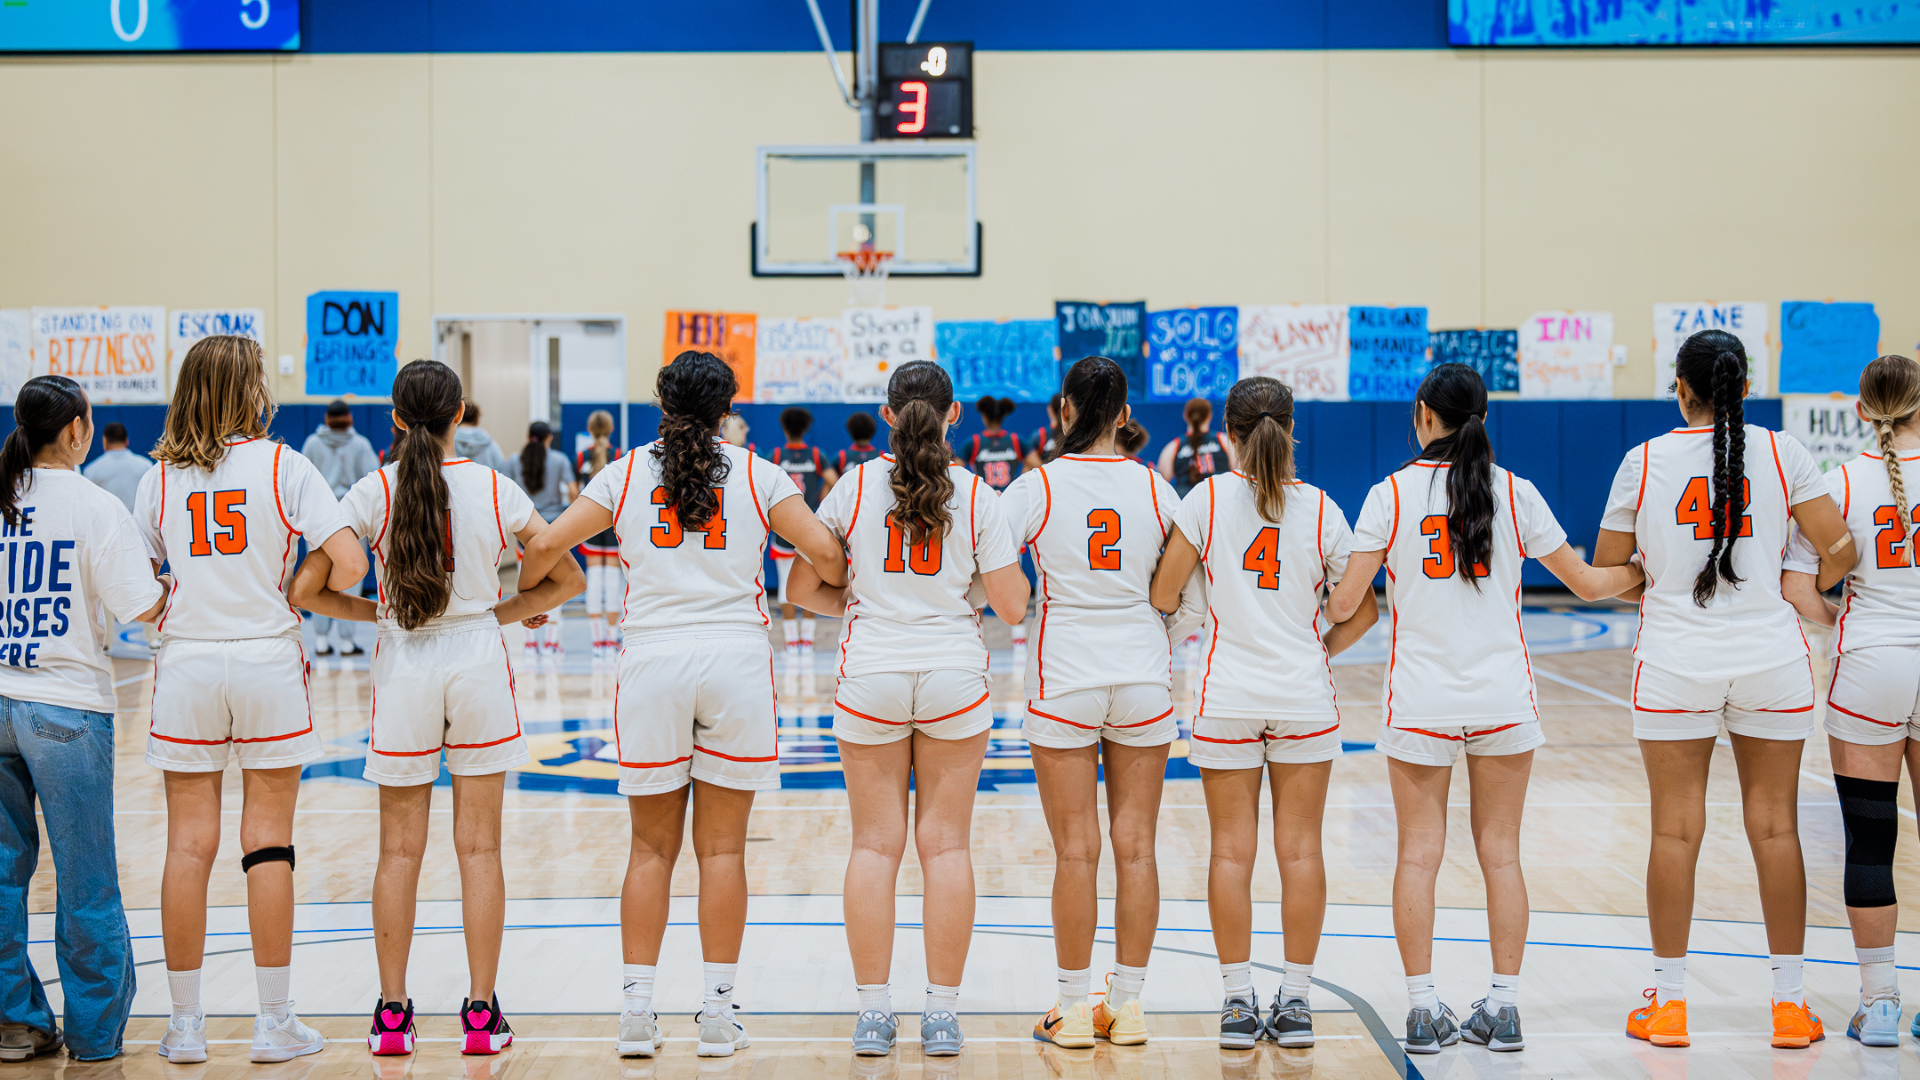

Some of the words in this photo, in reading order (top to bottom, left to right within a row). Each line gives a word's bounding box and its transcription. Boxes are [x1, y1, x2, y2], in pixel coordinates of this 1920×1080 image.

[896, 81, 928, 132] 3
[40, 313, 122, 334] STANDING
[129, 313, 153, 331] ON
[179, 311, 257, 338] ESCOBAR
[323, 301, 384, 335] DON
[851, 311, 920, 337] Shoot
[1151, 311, 1238, 350] SOLO
[1537, 318, 1591, 342] IAN
[1671, 305, 1743, 332] ZANE
[49, 333, 155, 376] BIZZNESS
[315, 339, 390, 363] BRINGS
[1430, 330, 1503, 356] MAGIC
[318, 365, 341, 388] IT
[344, 365, 376, 388] ON
[1152, 361, 1237, 397] LOCO
[983, 461, 1011, 488] 13
[0, 506, 36, 537] HE
[186, 489, 248, 557] 15
[650, 485, 727, 550] 34
[1675, 476, 1753, 540] 42
[883, 509, 944, 576] 10
[1086, 508, 1122, 571] 2
[1420, 514, 1491, 579] 3
[1242, 526, 1281, 590] 4
